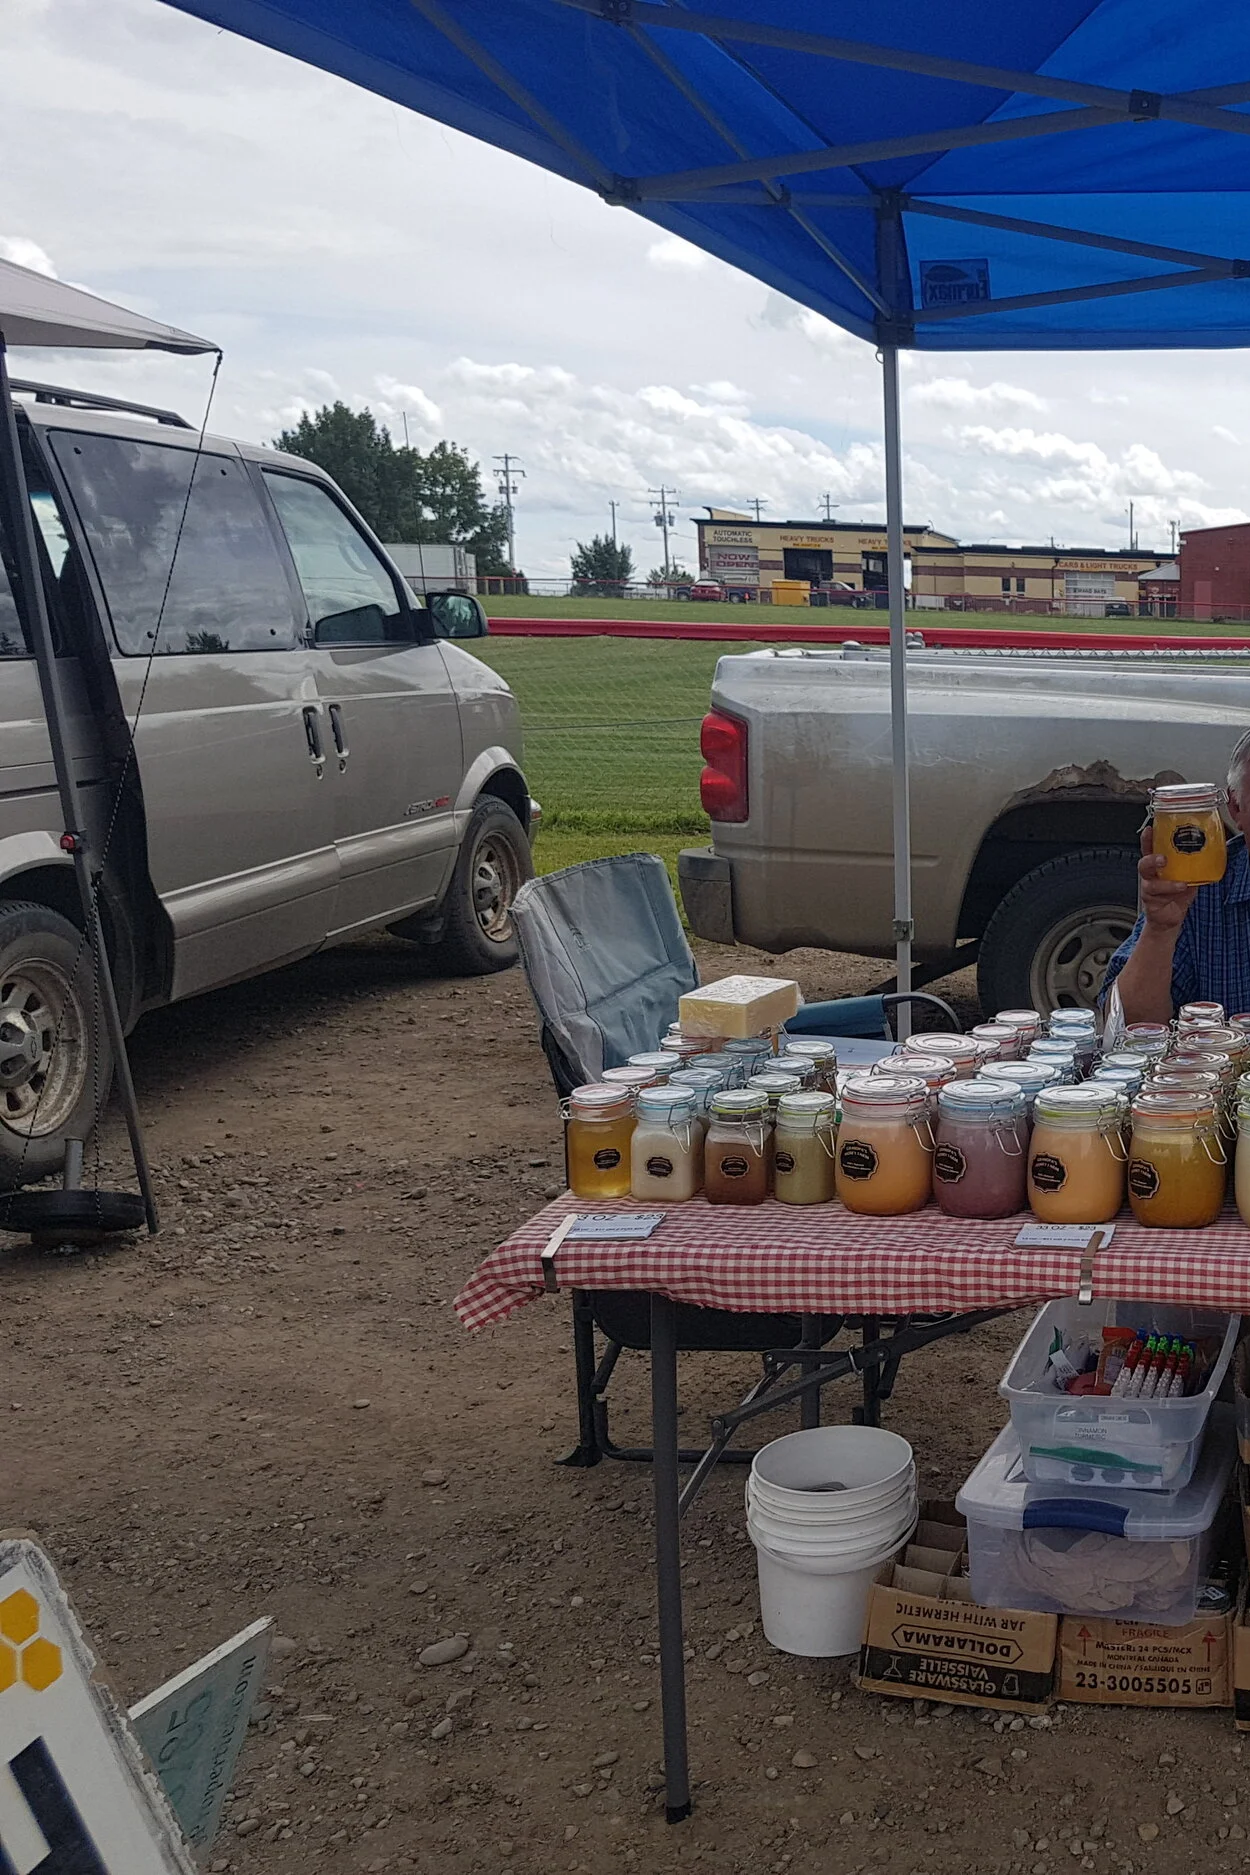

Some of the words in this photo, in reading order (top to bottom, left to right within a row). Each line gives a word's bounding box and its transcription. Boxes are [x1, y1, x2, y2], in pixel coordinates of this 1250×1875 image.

[713, 536, 753, 544] TOUCHLESS
[780, 535, 804, 543] HEAVY
[806, 536, 835, 544] TRUCKS
[718, 553, 751, 561] NOW
[896, 1602, 960, 1623] HERMETIC
[963, 1612, 997, 1628] WITH
[1001, 1618, 1026, 1632] JAR
[1122, 1628, 1170, 1640] FRAGILE
[902, 1630, 1012, 1658] DOLLARAMA
[1096, 1641, 1136, 1653] MASTER:
[1152, 1646, 1193, 1655] PCS/MCX
[1077, 1659, 1097, 1668] MADE
[1108, 1663, 1132, 1671] CHINA
[1107, 1654, 1146, 1663] MONTREAL
[920, 1658, 990, 1680] VAISSELLE
[908, 1669, 997, 1694] GLASSWARE
[1075, 1672, 1192, 1694] 23-3005505
